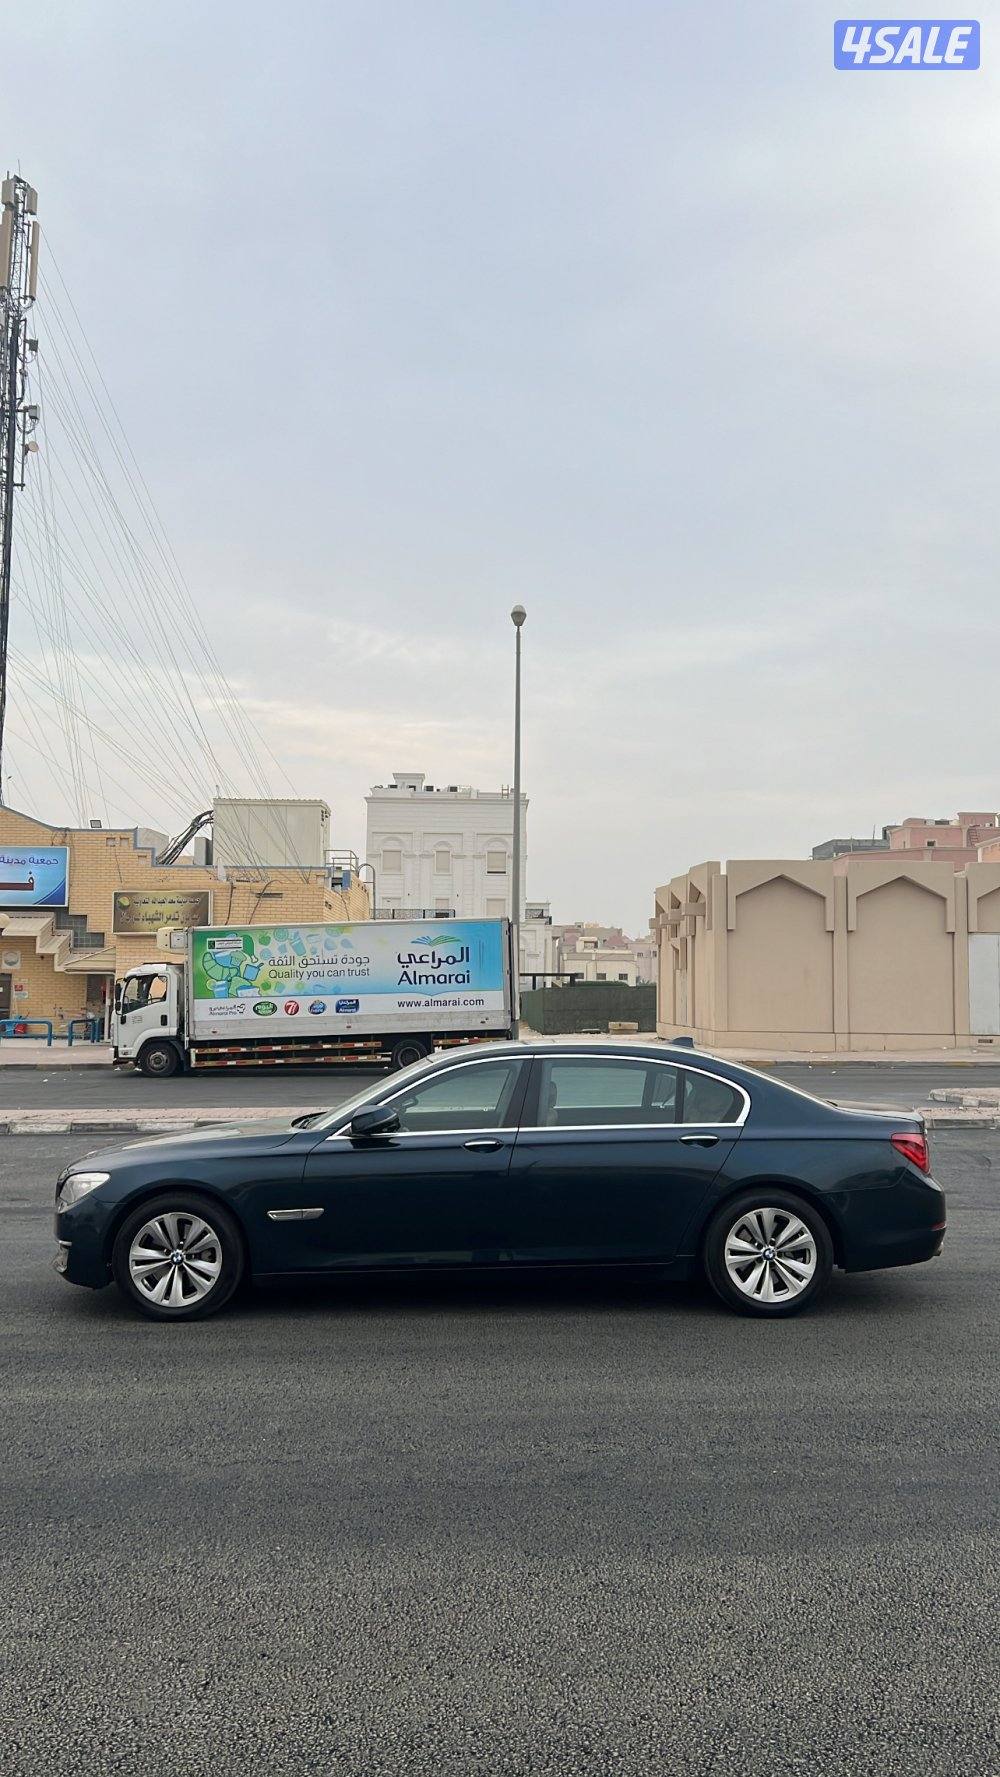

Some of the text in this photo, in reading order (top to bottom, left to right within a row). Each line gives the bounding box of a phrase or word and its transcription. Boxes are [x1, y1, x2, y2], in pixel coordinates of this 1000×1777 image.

[268, 954, 370, 969] جودة تستحق الثقة
[397, 946, 470, 969] المراعي
[268, 968, 370, 980] Quality you can trust
[397, 969, 471, 986] Almarai
[397, 998, 485, 1008] www.almarai.com
